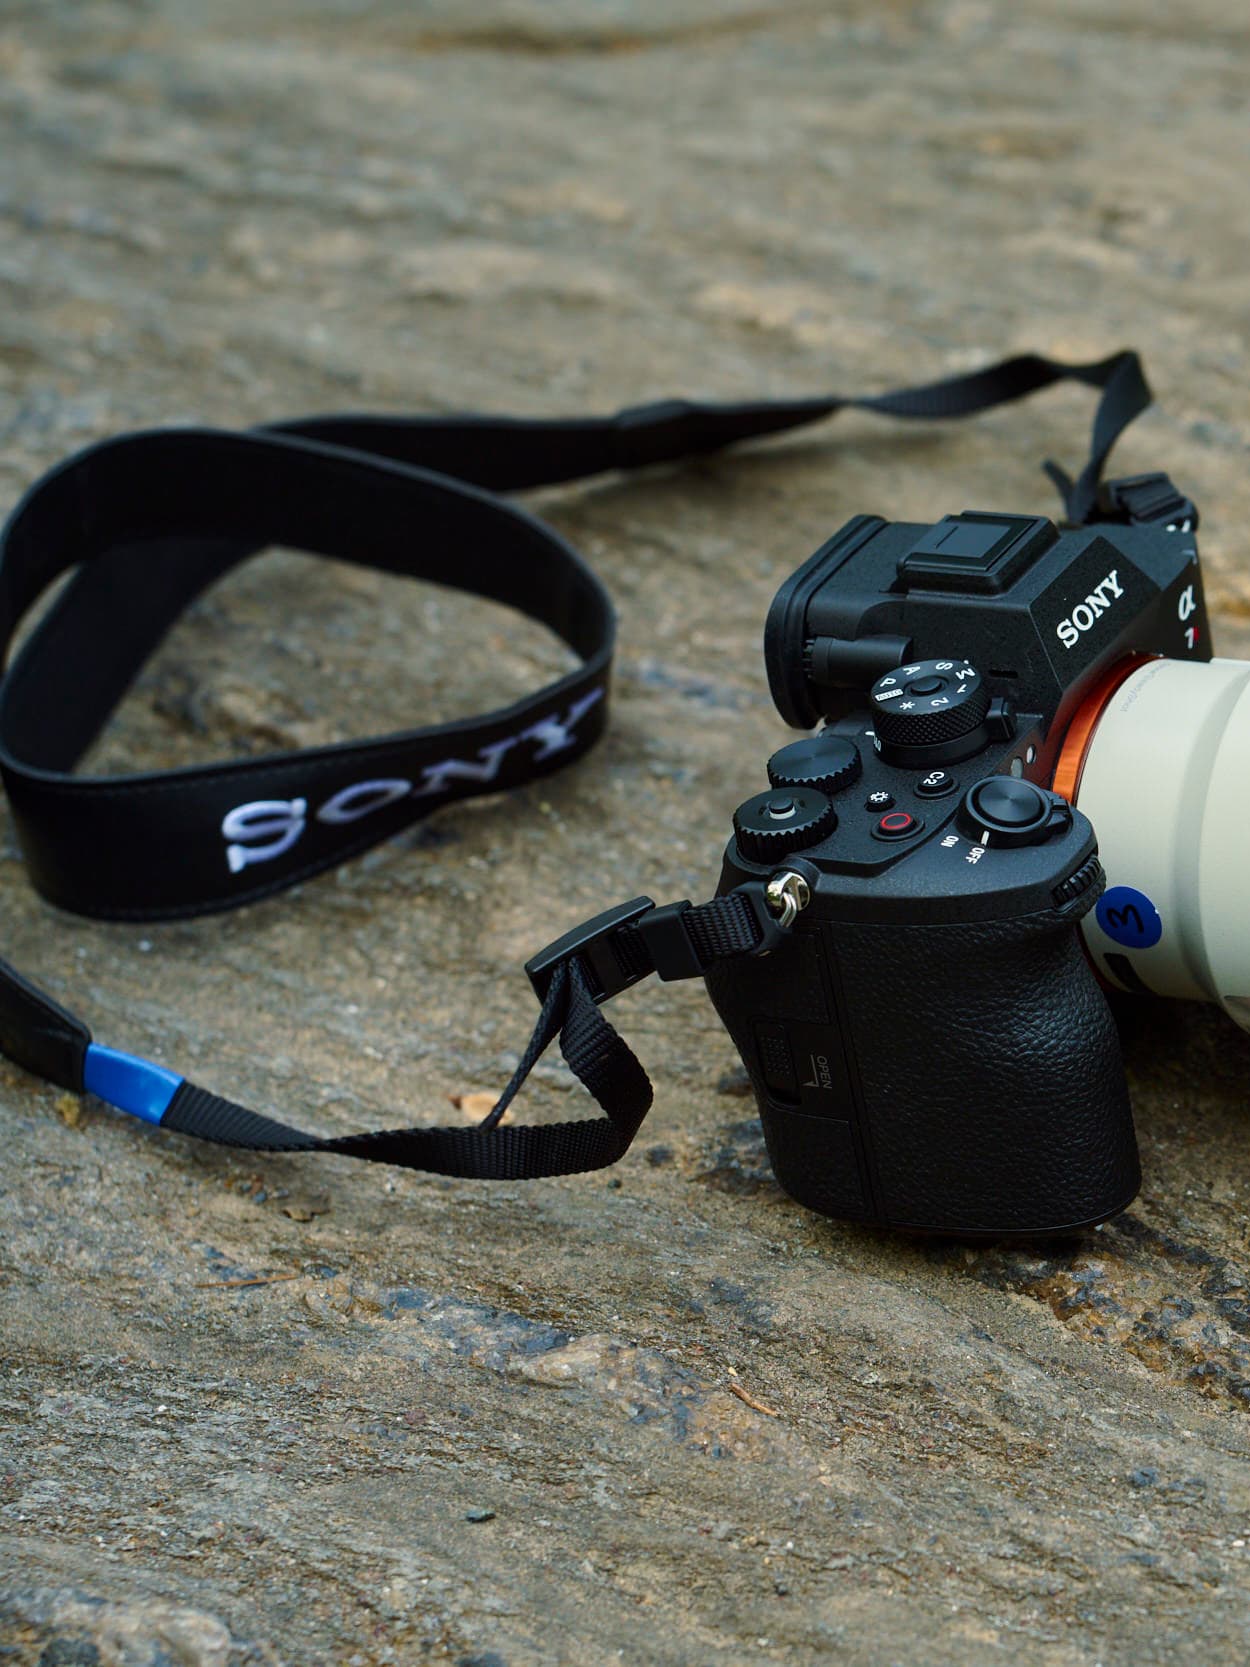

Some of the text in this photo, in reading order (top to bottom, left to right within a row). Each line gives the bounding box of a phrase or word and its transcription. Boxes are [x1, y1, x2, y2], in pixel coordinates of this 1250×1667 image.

[1056, 569, 1124, 649] SONY
[903, 666, 921, 675] A
[935, 661, 953, 671] S
[955, 668, 976, 680] M
[880, 677, 897, 687] P
[930, 697, 949, 706] 2
[221, 688, 604, 873] SONY
[923, 771, 945, 785] C2
[940, 835, 960, 848] ON
[965, 847, 985, 865] OFF
[816, 1055, 833, 1089] OPEN
